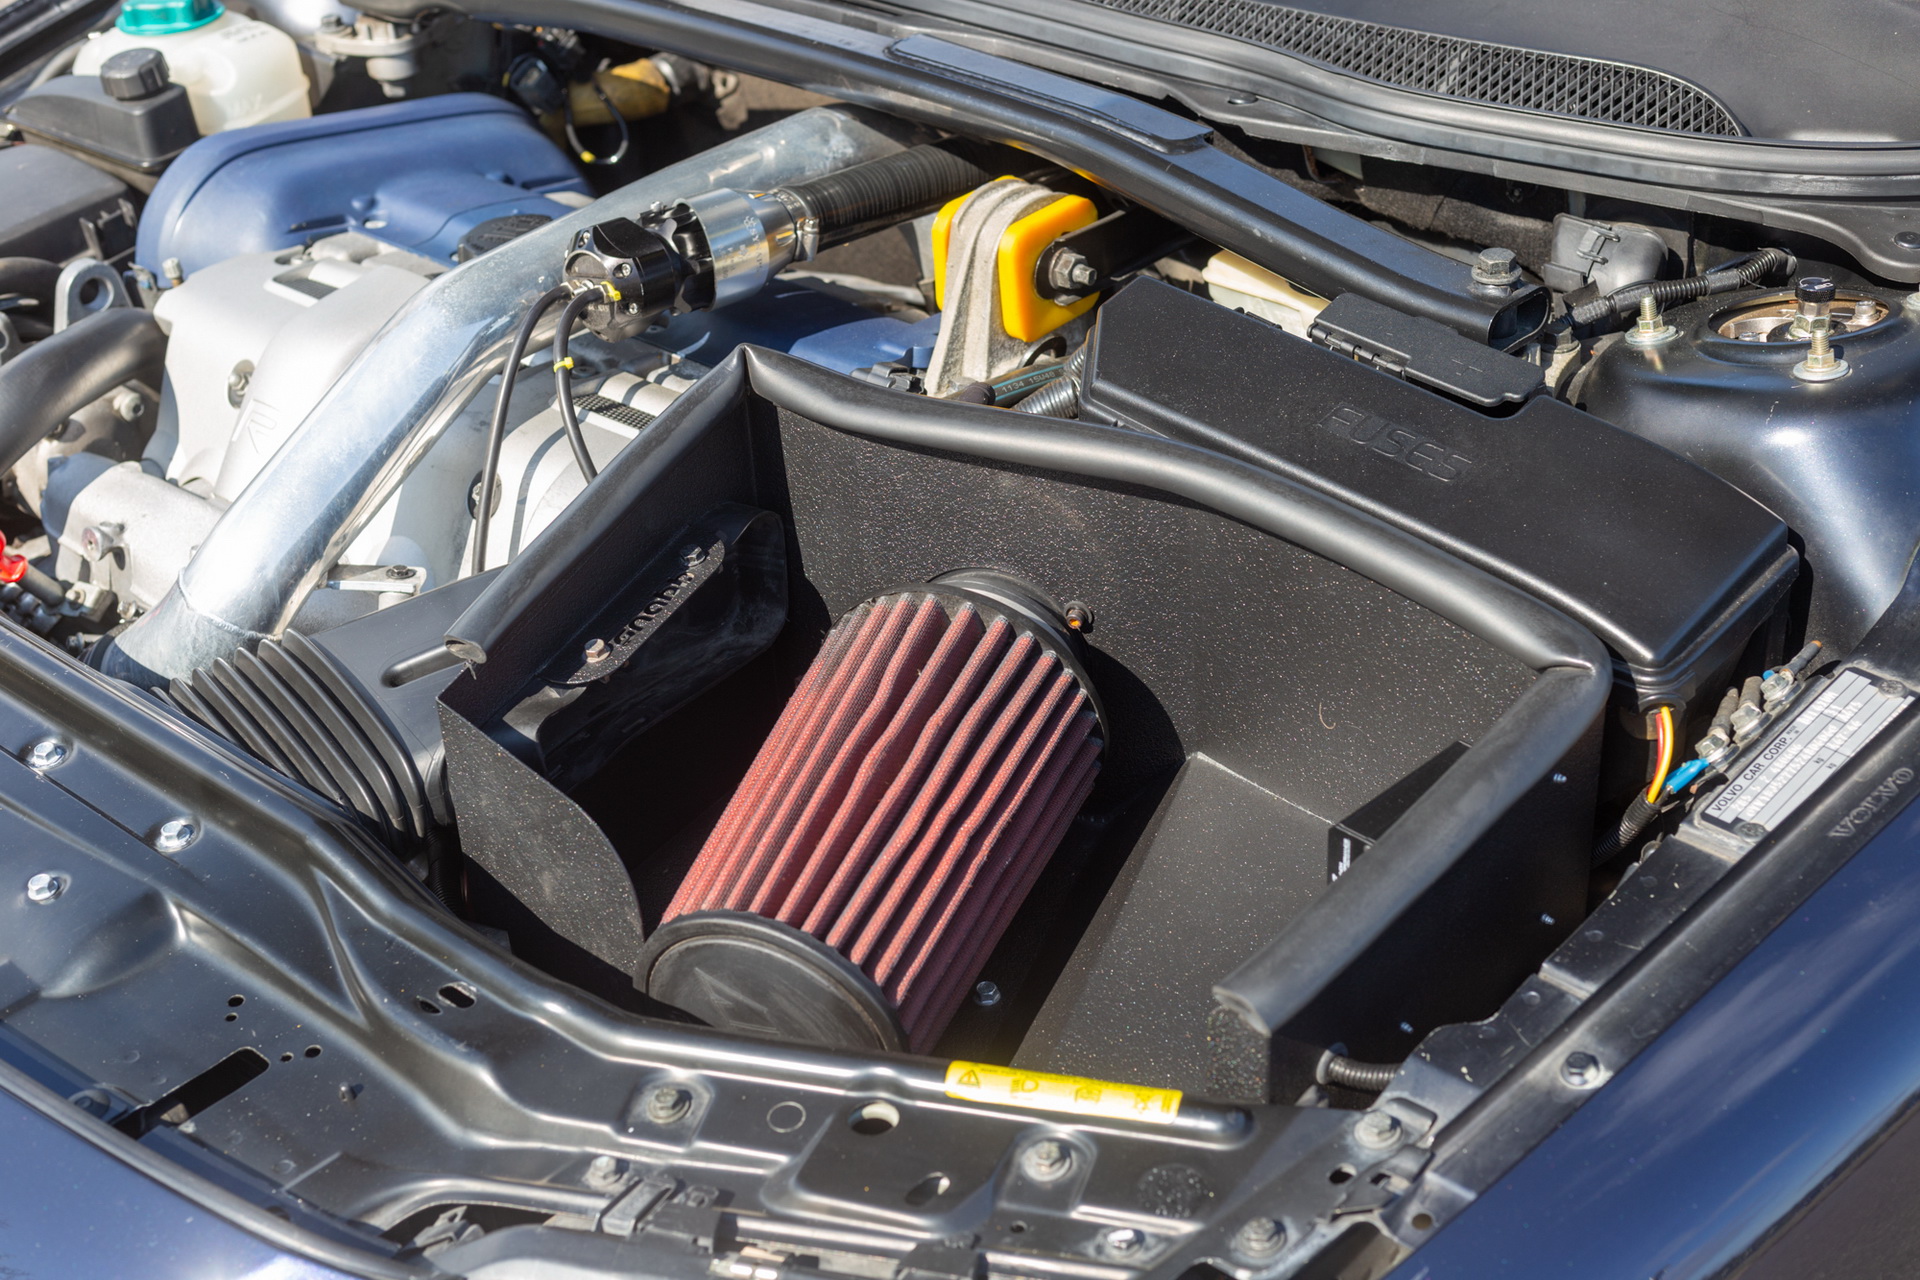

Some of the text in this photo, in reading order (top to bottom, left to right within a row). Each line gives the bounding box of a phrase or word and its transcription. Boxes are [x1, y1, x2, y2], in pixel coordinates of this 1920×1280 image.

[1001, 380, 1025, 393] 1134
[1318, 402, 1473, 482] FUSES
[1712, 737, 1793, 812] VOLVO CAR CORP.
[1827, 766, 1914, 838] VOLVO
